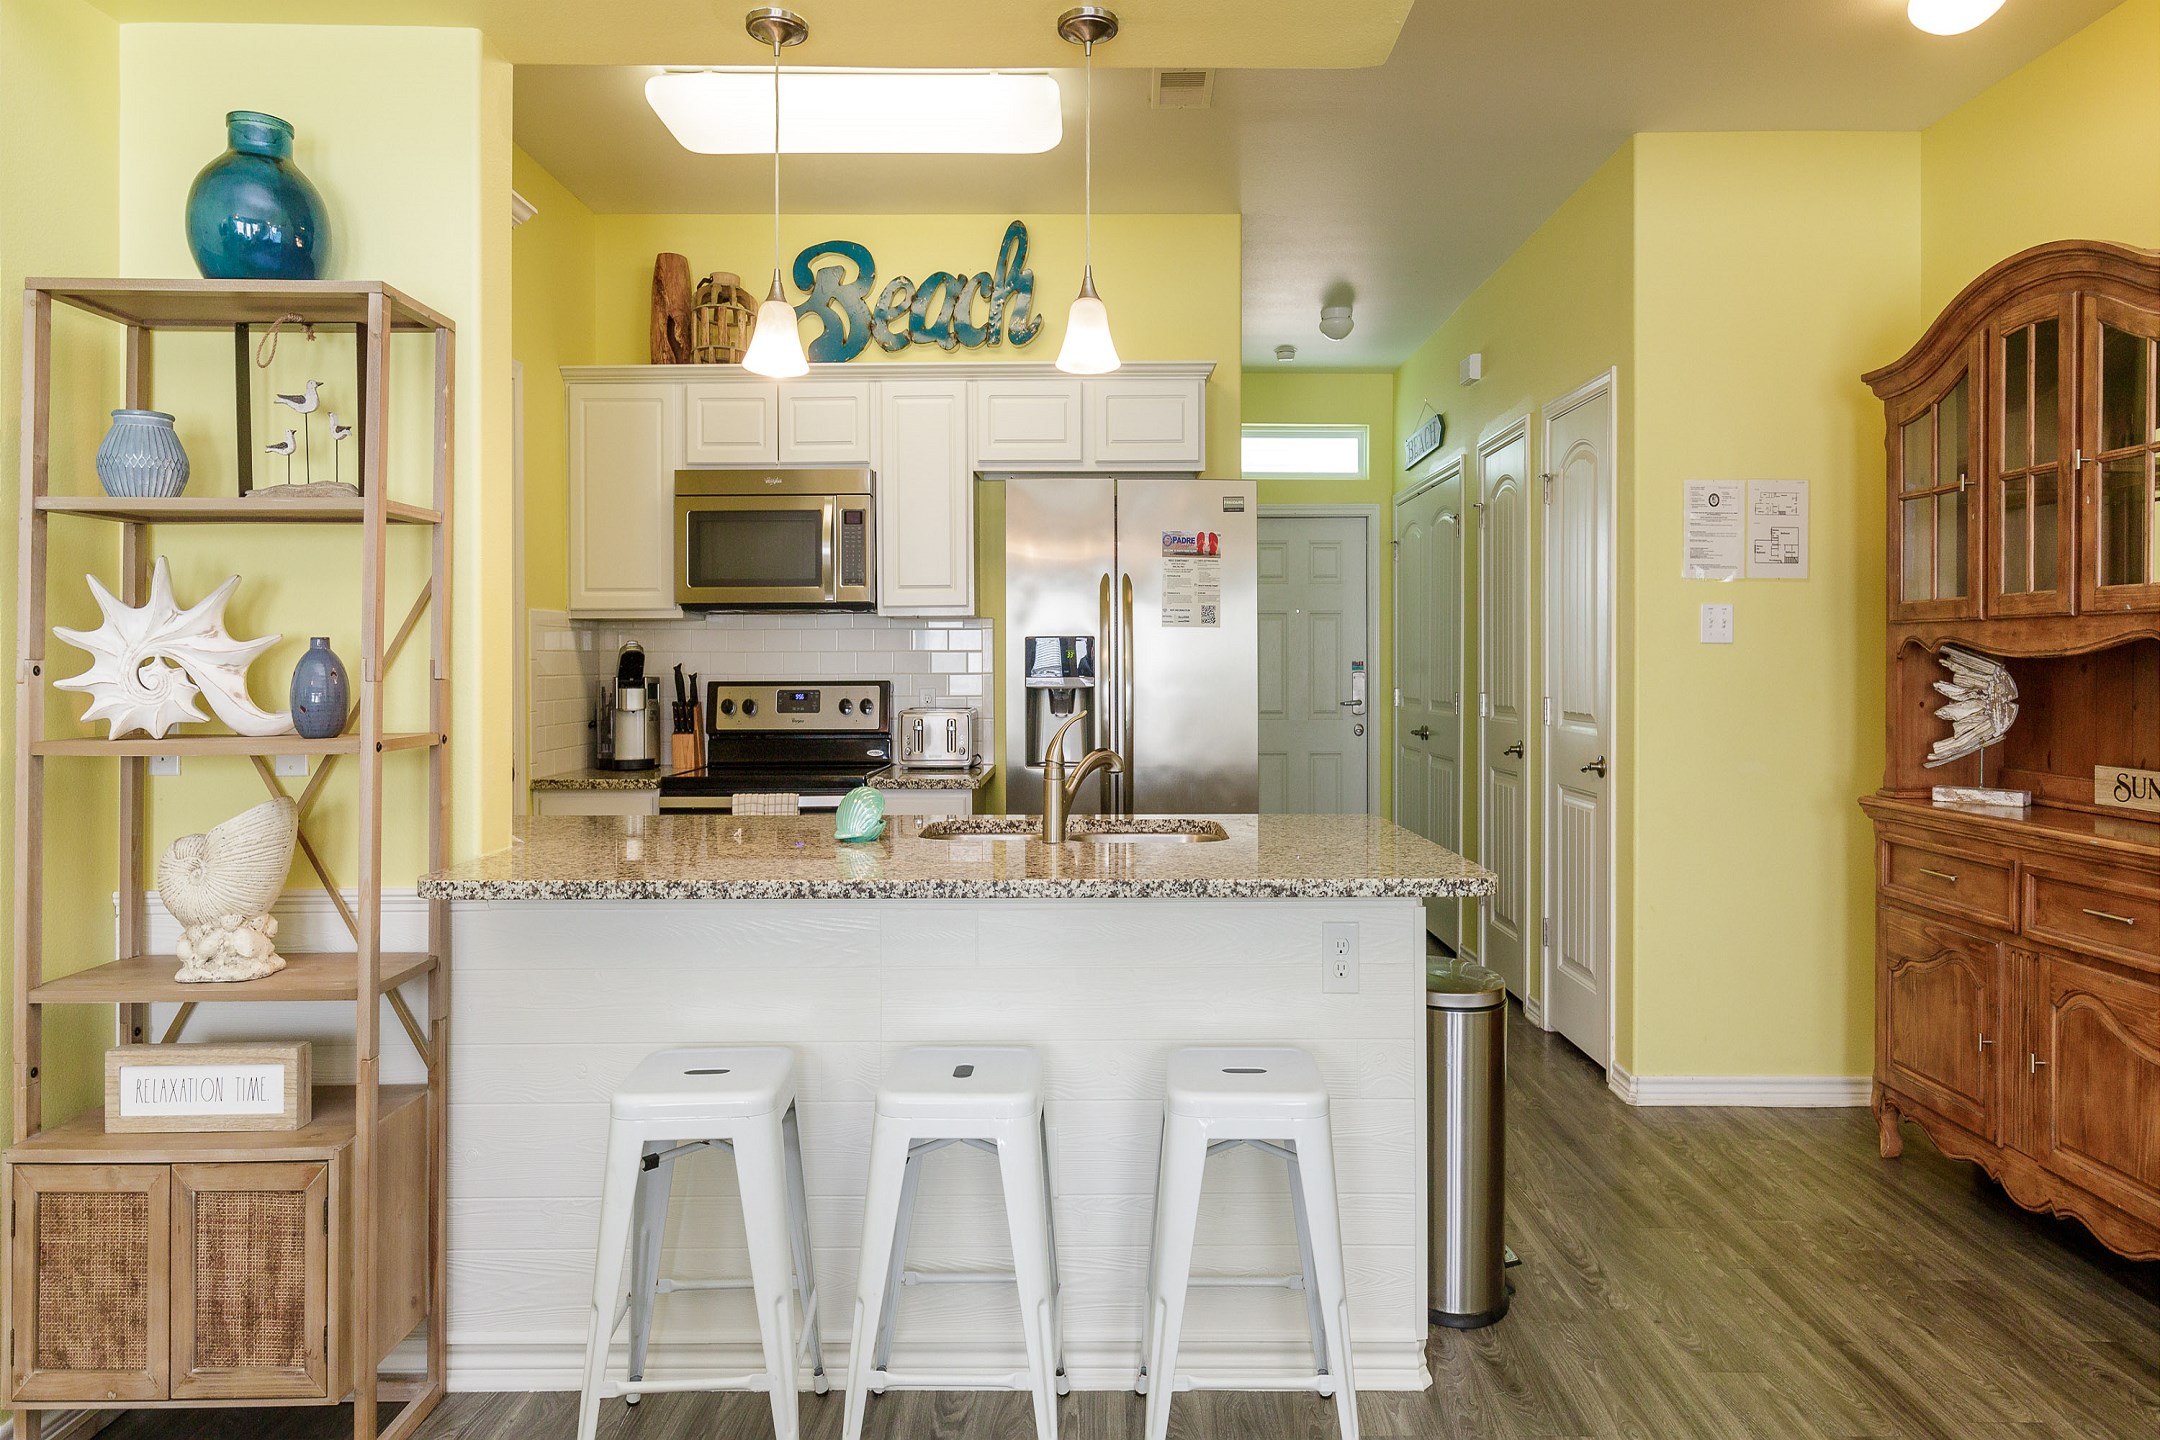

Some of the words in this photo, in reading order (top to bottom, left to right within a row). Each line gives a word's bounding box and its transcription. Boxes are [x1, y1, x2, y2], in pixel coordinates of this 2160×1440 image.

[793, 220, 1042, 362] Beach
[1407, 421, 1437, 463] BEACH
[1172, 536, 1195, 544] PADRE
[135, 1077, 224, 1104] RELAXATION
